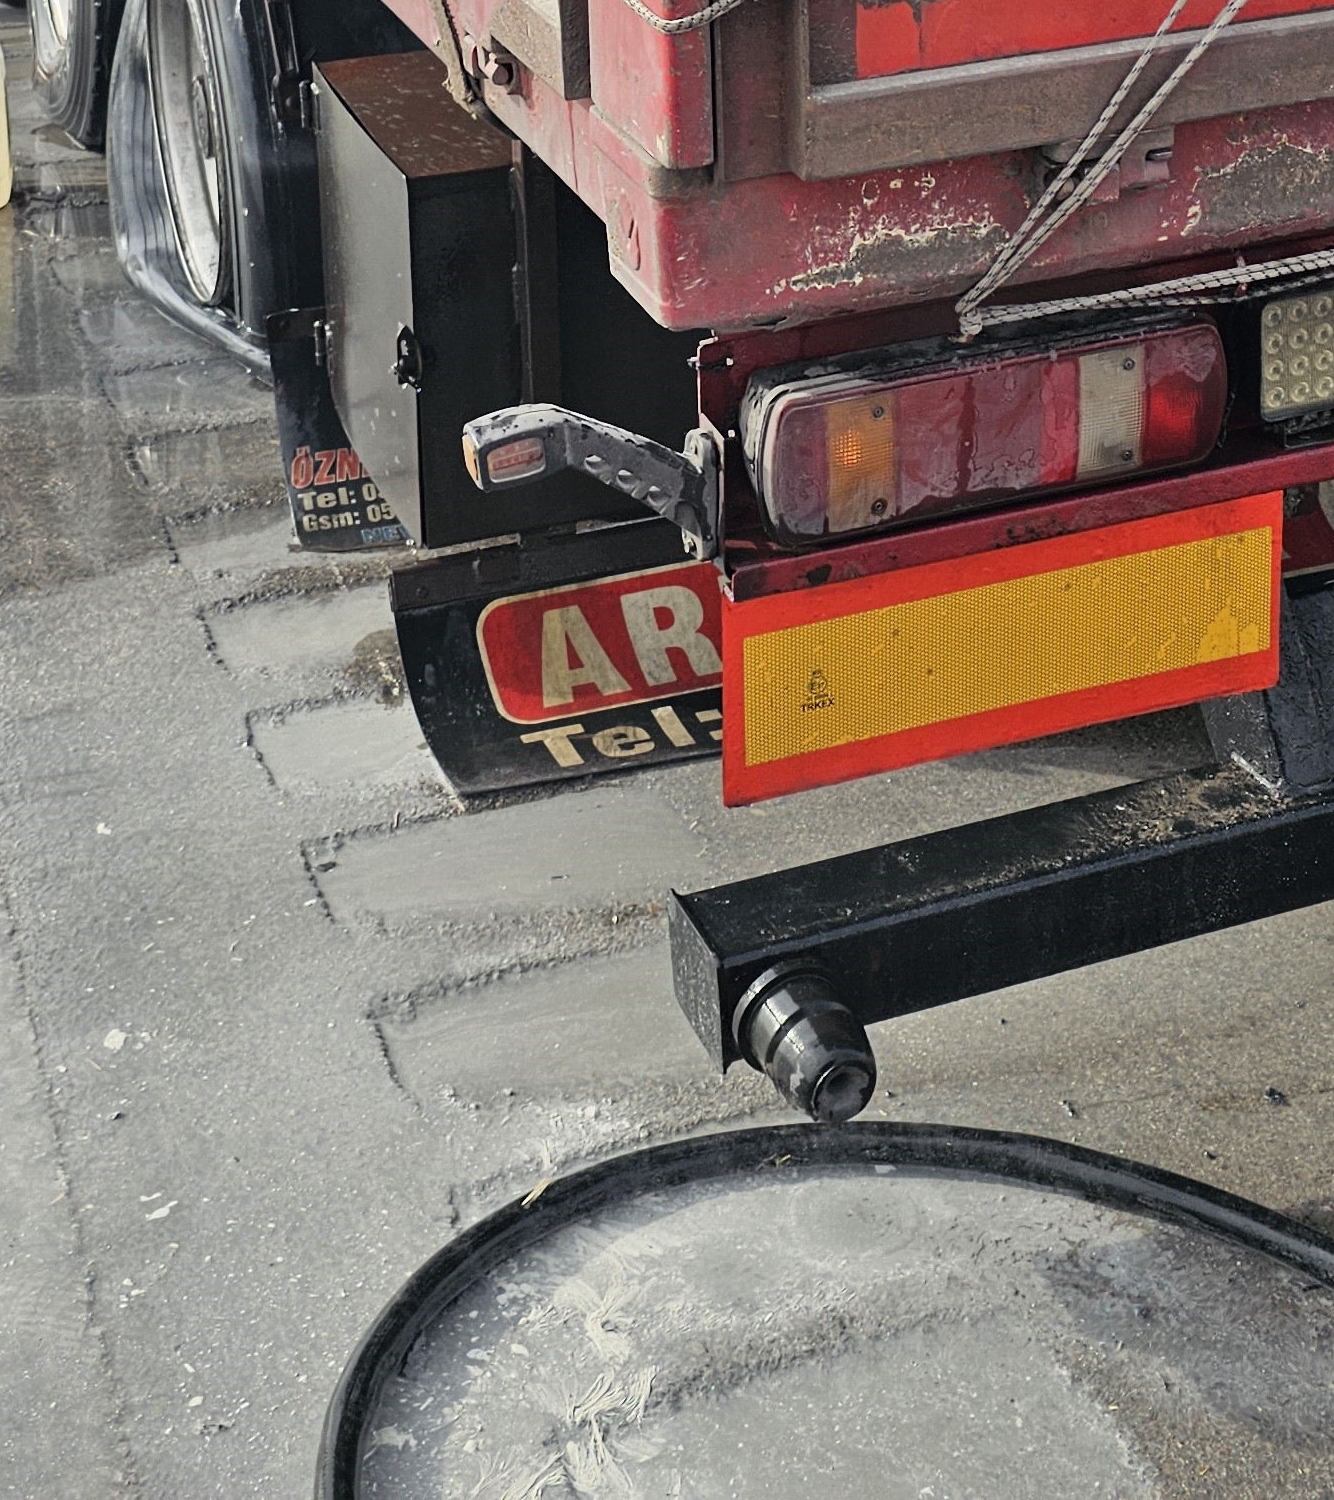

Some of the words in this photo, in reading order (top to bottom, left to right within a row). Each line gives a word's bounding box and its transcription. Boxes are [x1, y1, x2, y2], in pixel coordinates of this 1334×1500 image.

[297, 486, 357, 512] Tel:
[302, 511, 361, 533] Gsm:
[520, 705, 723, 768] Tel:
